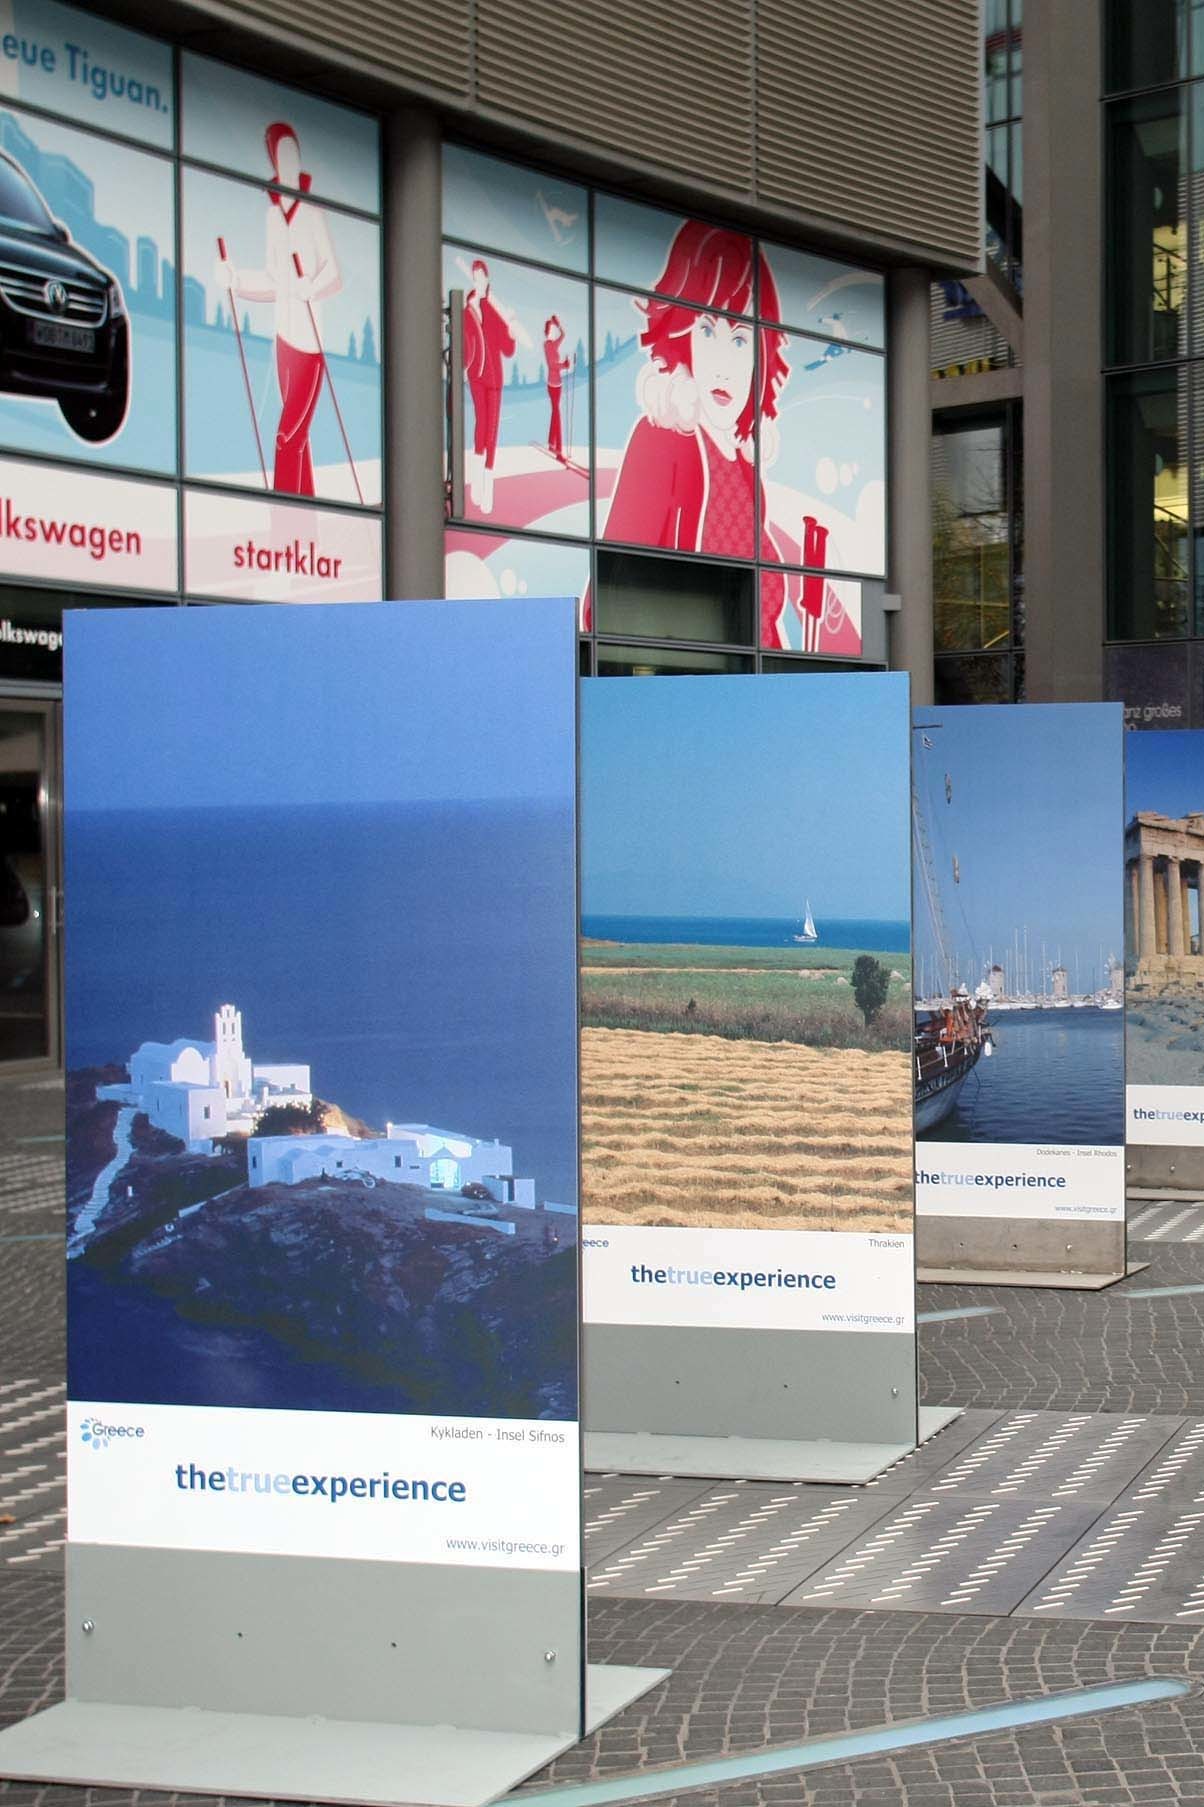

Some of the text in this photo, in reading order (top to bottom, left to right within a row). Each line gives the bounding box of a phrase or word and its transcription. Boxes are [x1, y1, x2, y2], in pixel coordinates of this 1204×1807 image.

[2, 33, 168, 114] eue Tiguan.
[233, 539, 343, 579] startklar
[868, 1238, 905, 1249] Thrakien
[631, 1265, 837, 1291] thetrueexperience
[821, 1312, 905, 1326] www.visitgreece.gr
[92, 1421, 145, 1438] Greece
[431, 1425, 484, 1440] Kykladen
[496, 1428, 525, 1441] Insel
[528, 1430, 566, 1443] Sifnos
[176, 1464, 467, 1502] thetrueexperience
[446, 1536, 566, 1556] www.visitgreece.gr
